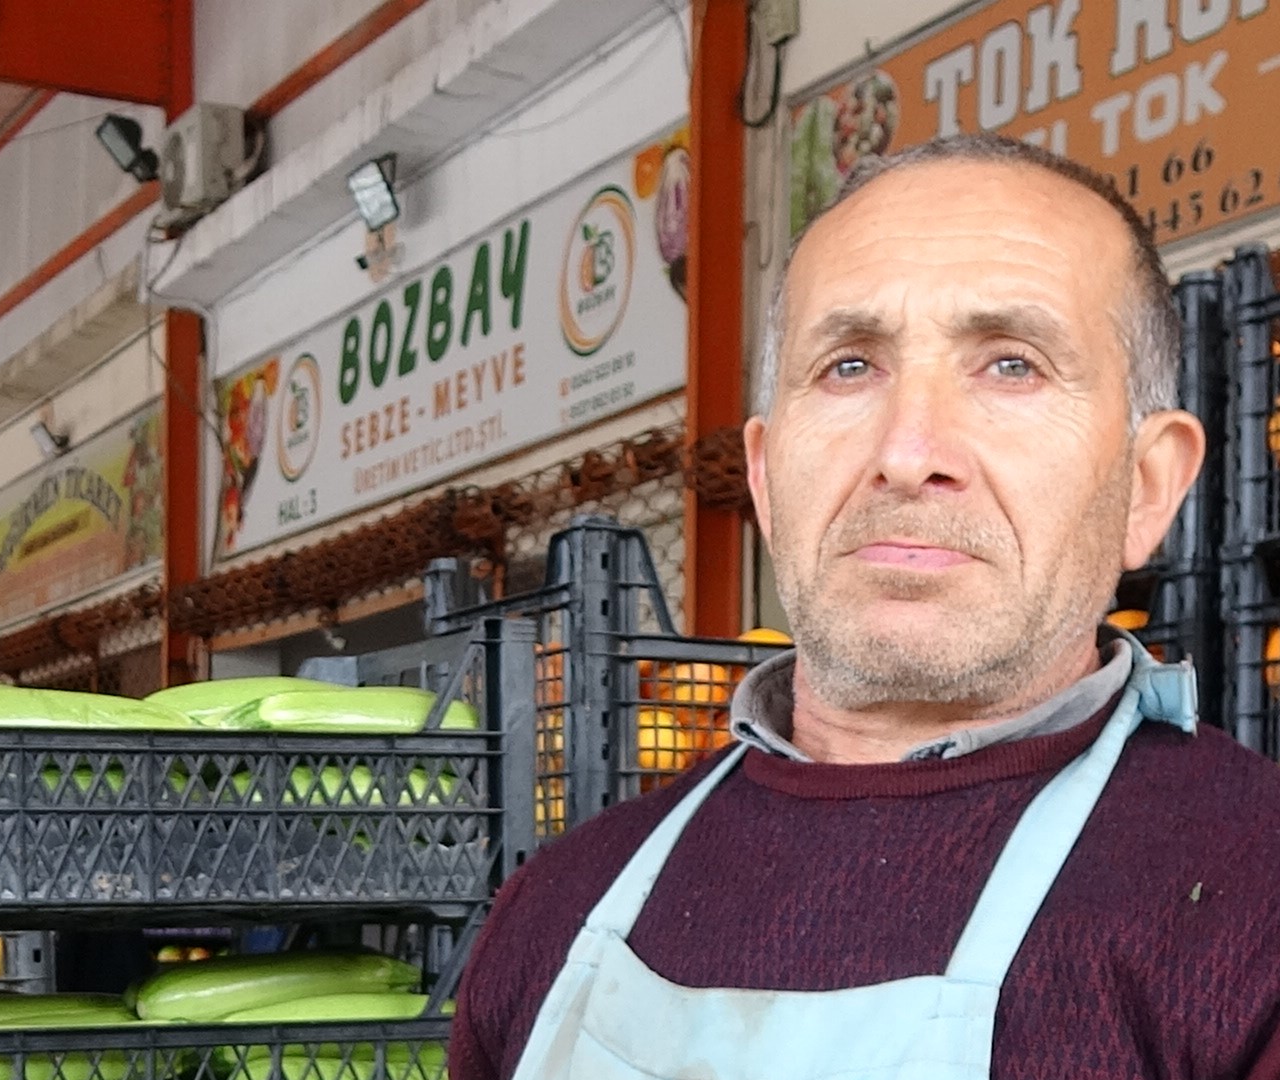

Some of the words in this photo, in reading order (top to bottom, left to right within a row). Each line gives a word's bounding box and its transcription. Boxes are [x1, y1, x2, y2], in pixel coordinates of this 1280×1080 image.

[924, 0, 1083, 138] TOK
[1091, 50, 1229, 156] TOK
[1161, 138, 1214, 185] 66
[1219, 168, 1265, 214] 62
[338, 217, 531, 405] BOZBAY
[339, 394, 411, 463] SEBZE
[431, 341, 526, 421] MEYVE
